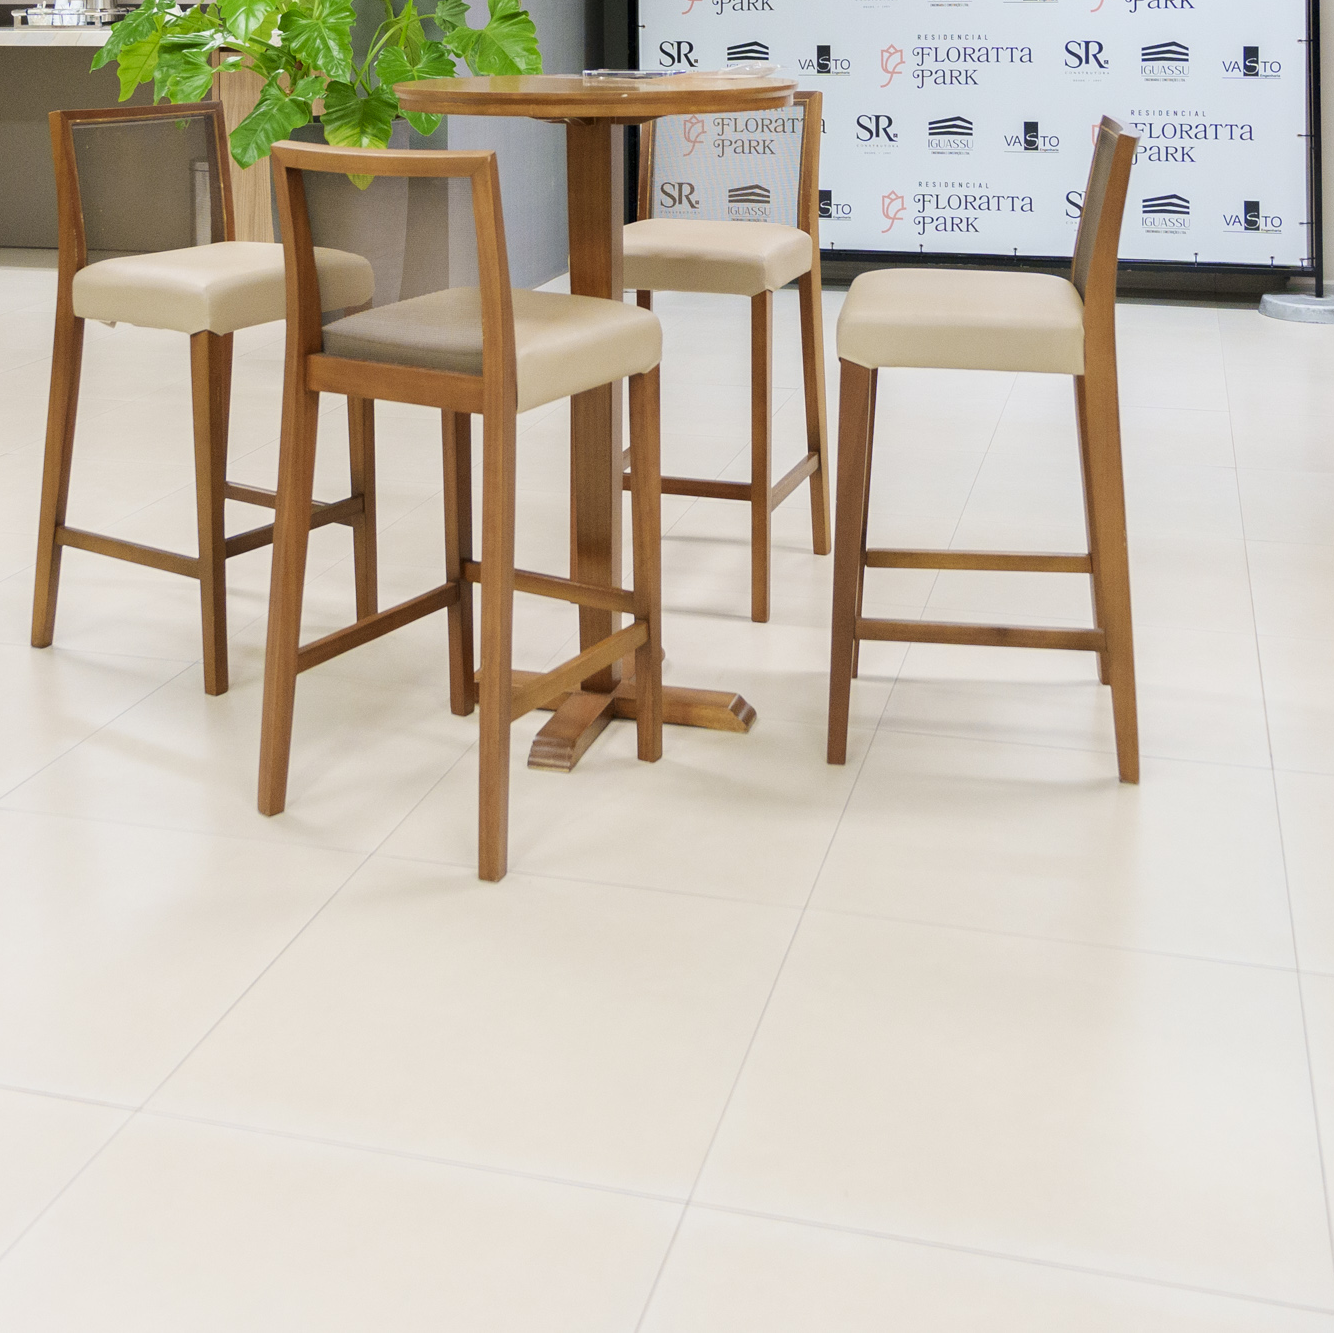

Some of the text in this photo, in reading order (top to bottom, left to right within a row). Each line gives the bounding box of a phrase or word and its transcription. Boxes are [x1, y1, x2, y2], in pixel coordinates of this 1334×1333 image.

[659, 41, 698, 67] SR
[1065, 40, 1109, 69] SR
[798, 58, 850, 71] VASTO
[1141, 65, 1189, 75] IGUASSU
[1222, 61, 1281, 75] VASTO
[856, 115, 898, 142] SR
[928, 139, 973, 149] IGUASSU
[1004, 135, 1060, 149] VASTO
[919, 181, 988, 189] RESIDENCIAL
[660, 182, 699, 209] SR
[728, 206, 770, 217] IGUASSU
[819, 202, 852, 217] STO
[1065, 191, 1085, 218] S
[1142, 217, 1190, 228] IGUASSU
[1223, 214, 1282, 229] VASTO
